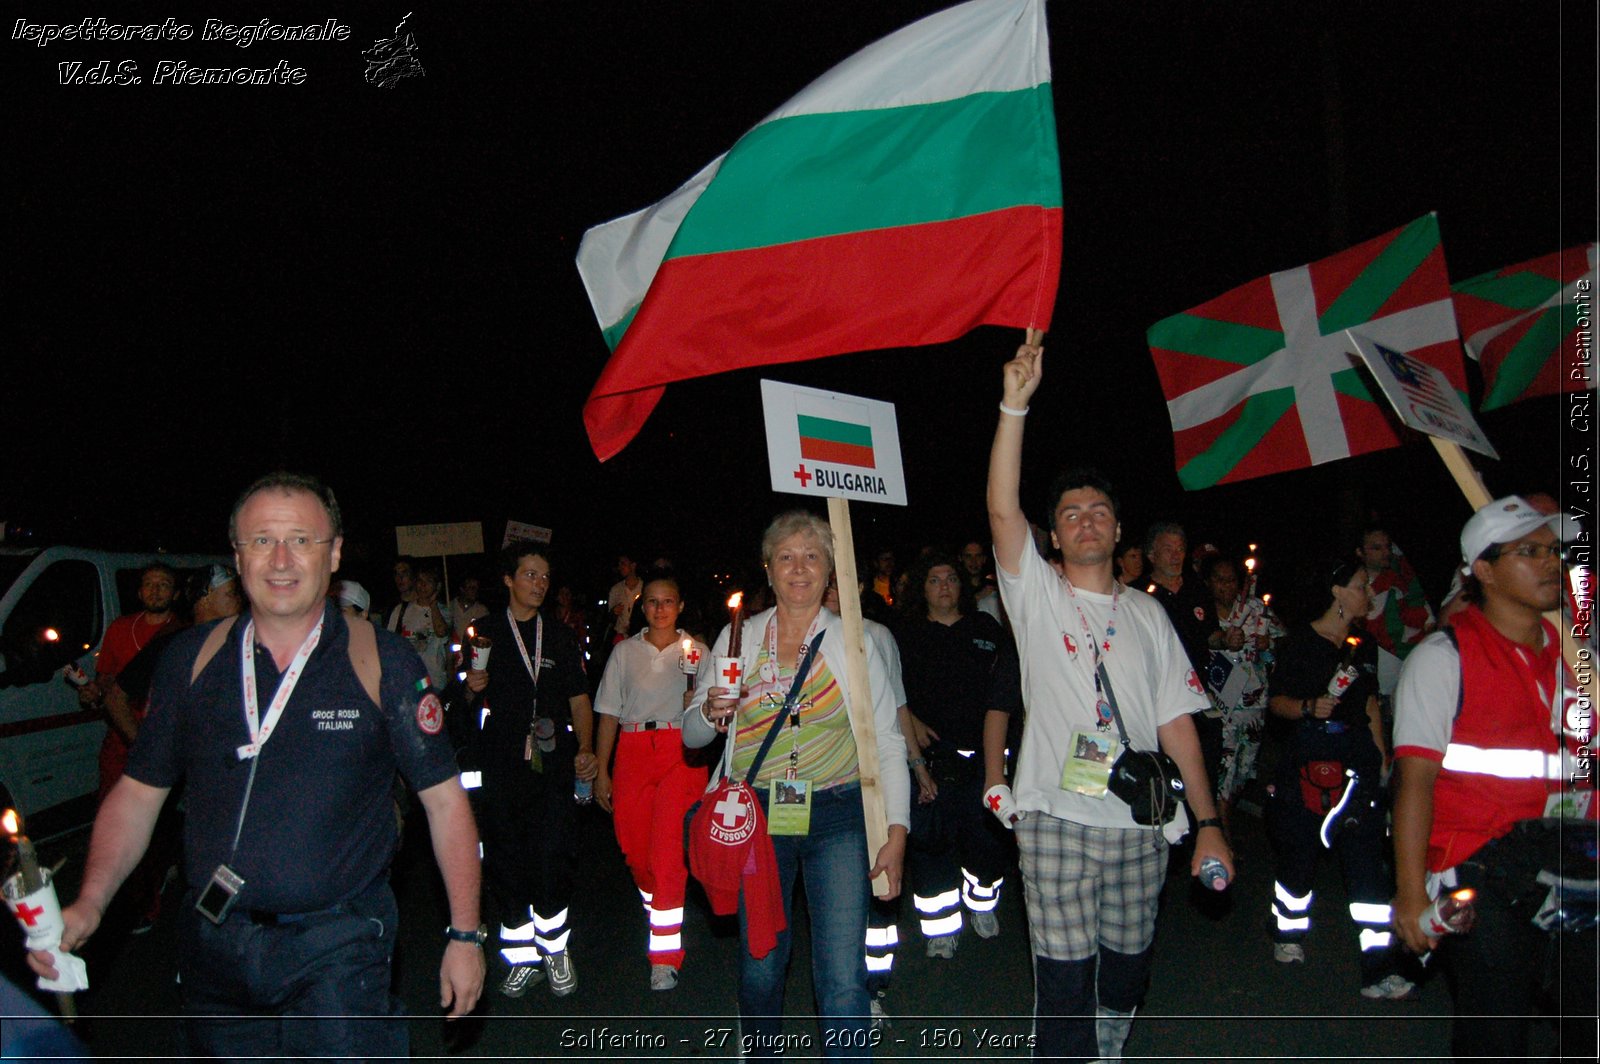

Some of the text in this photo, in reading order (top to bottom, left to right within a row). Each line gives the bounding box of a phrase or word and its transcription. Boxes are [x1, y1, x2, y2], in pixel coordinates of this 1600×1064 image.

[815, 468, 887, 495] BULGARIA
[312, 709, 360, 720] CROCE ROSSA
[318, 720, 354, 730] ITALIANA
[719, 829, 747, 841] ROSSA
